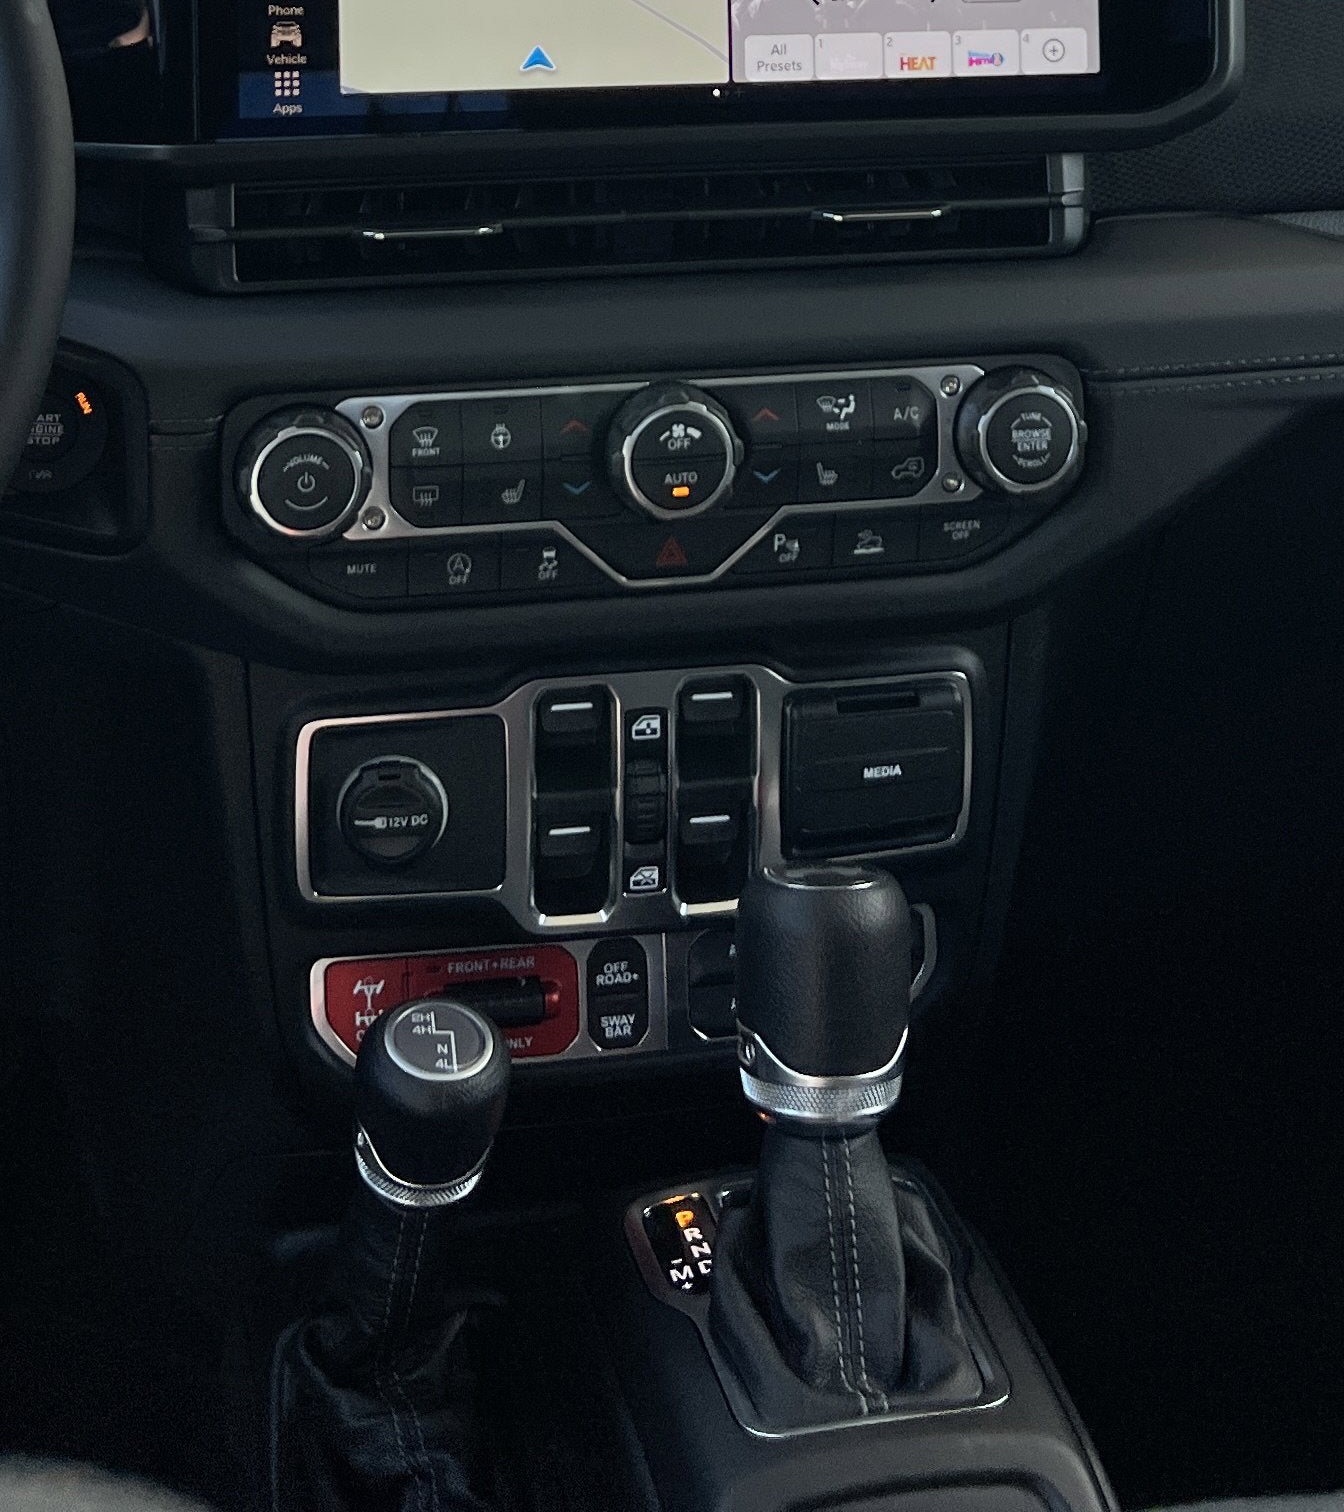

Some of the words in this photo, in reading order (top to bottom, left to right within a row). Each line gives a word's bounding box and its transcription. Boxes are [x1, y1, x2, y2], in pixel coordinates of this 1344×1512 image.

[267, 4, 305, 16] Phone
[770, 44, 787, 56] All
[266, 53, 307, 66] Vehicle
[756, 59, 803, 73] Presets
[899, 55, 937, 72] HEAT
[272, 102, 303, 116] Apps
[893, 404, 919, 421] A/C
[825, 421, 851, 433] MODE
[1011, 428, 1052, 442] BROWSE
[667, 437, 691, 451] OFF
[1016, 439, 1049, 453] ENTER
[411, 447, 441, 458] FRONT
[289, 454, 323, 468] VOLUME
[664, 470, 699, 485] AUTO
[942, 518, 981, 532] SCREEN
[952, 528, 971, 540] OFF
[346, 563, 378, 575] MUTE
[537, 570, 558, 582] OFF
[448, 573, 469, 586] OFF
[863, 764, 903, 780] MEDIA
[388, 816, 410, 829] 12V
[411, 814, 429, 827] DC
[603, 960, 629, 974] OFF
[600, 1013, 636, 1027] SWAY
[411, 1025, 431, 1035] 4H
[605, 1025, 632, 1039] BAR
[437, 1043, 449, 1055] N
[435, 1058, 450, 1070] 4L
[675, 1210, 695, 1228] P
[683, 1227, 704, 1242] R
[690, 1241, 712, 1258] N
[669, 1264, 695, 1282] M
